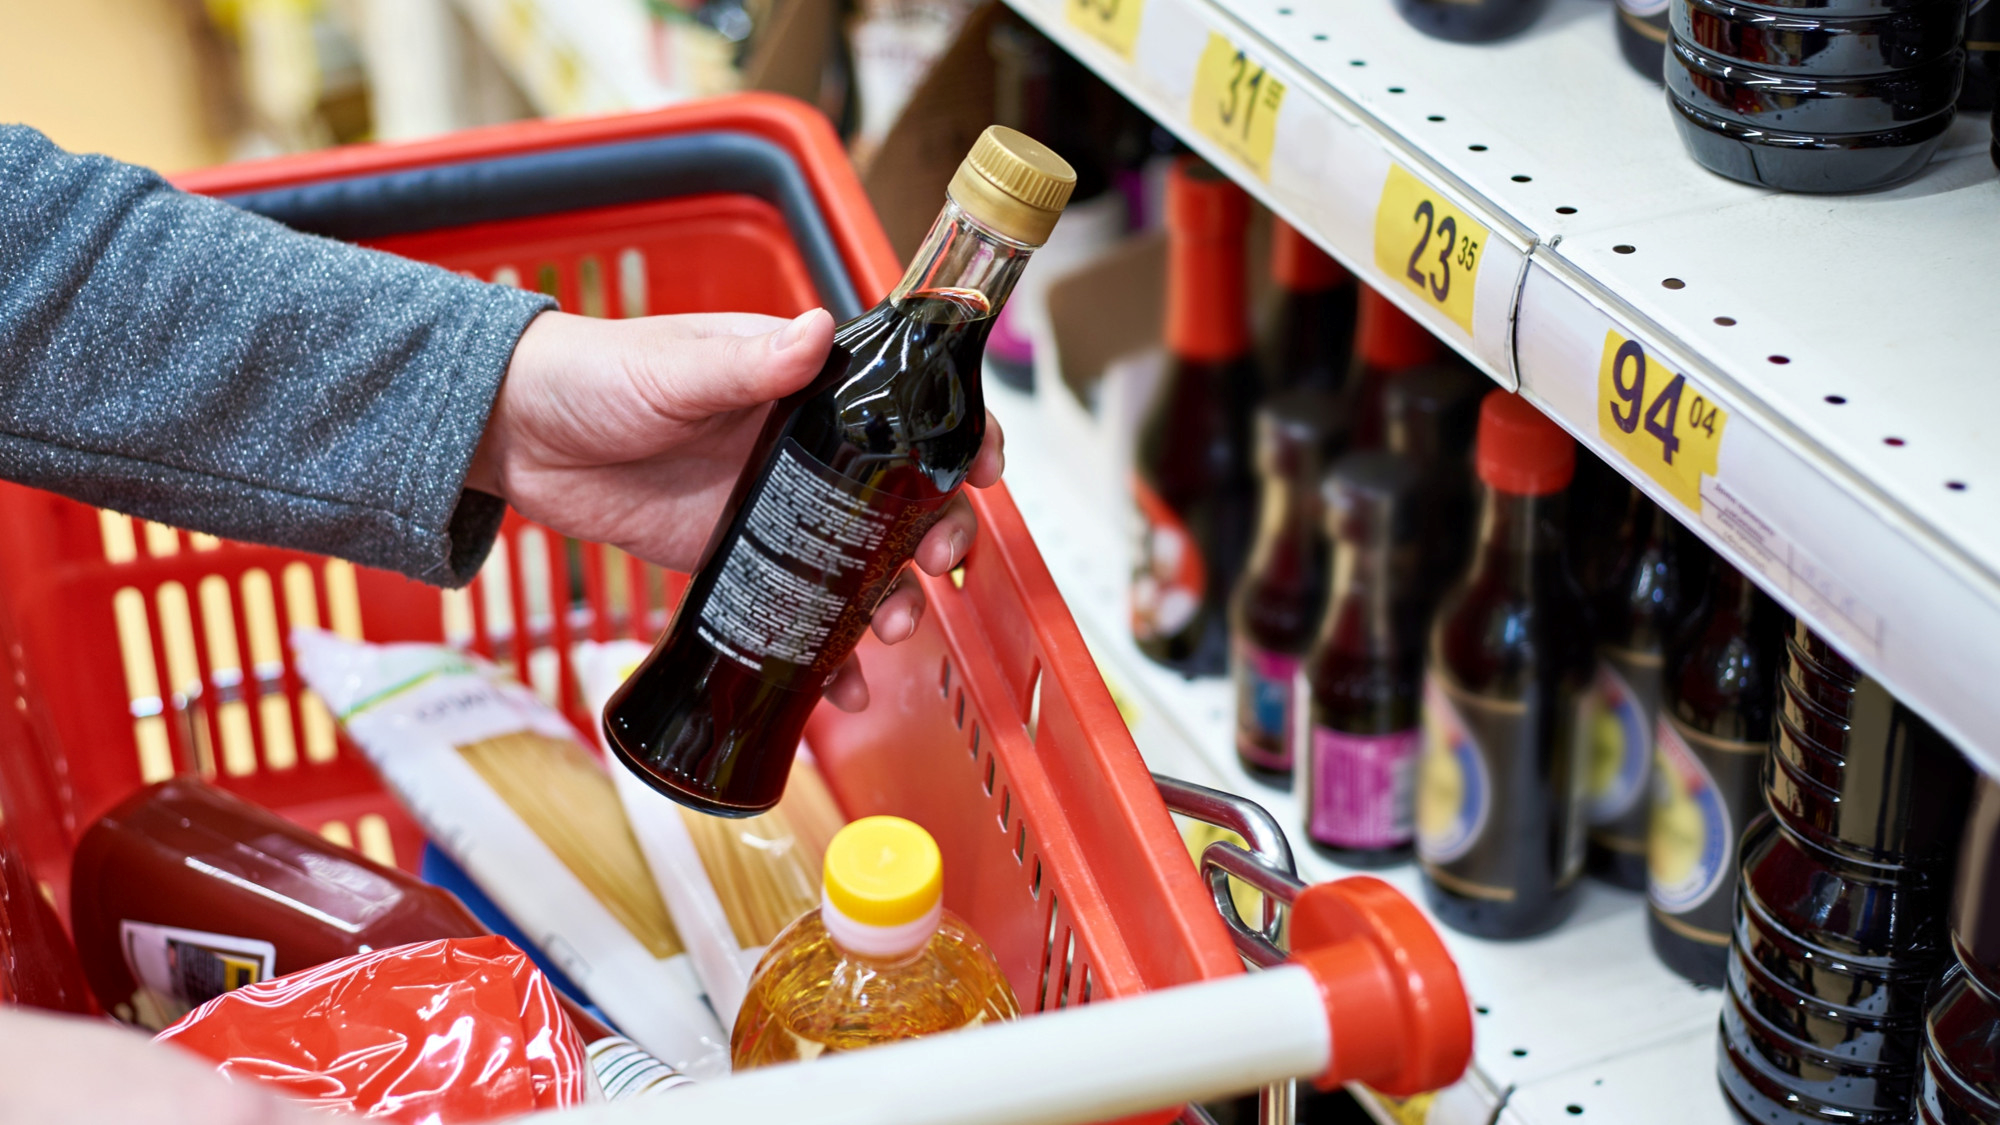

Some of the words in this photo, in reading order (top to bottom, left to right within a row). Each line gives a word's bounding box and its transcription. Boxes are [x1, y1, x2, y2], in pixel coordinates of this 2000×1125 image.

[1218, 51, 1266, 141] 31
[1407, 199, 1456, 302] 23
[1457, 236, 1478, 271] 35
[1610, 339, 1686, 465] 94
[1690, 396, 1719, 439] 04
